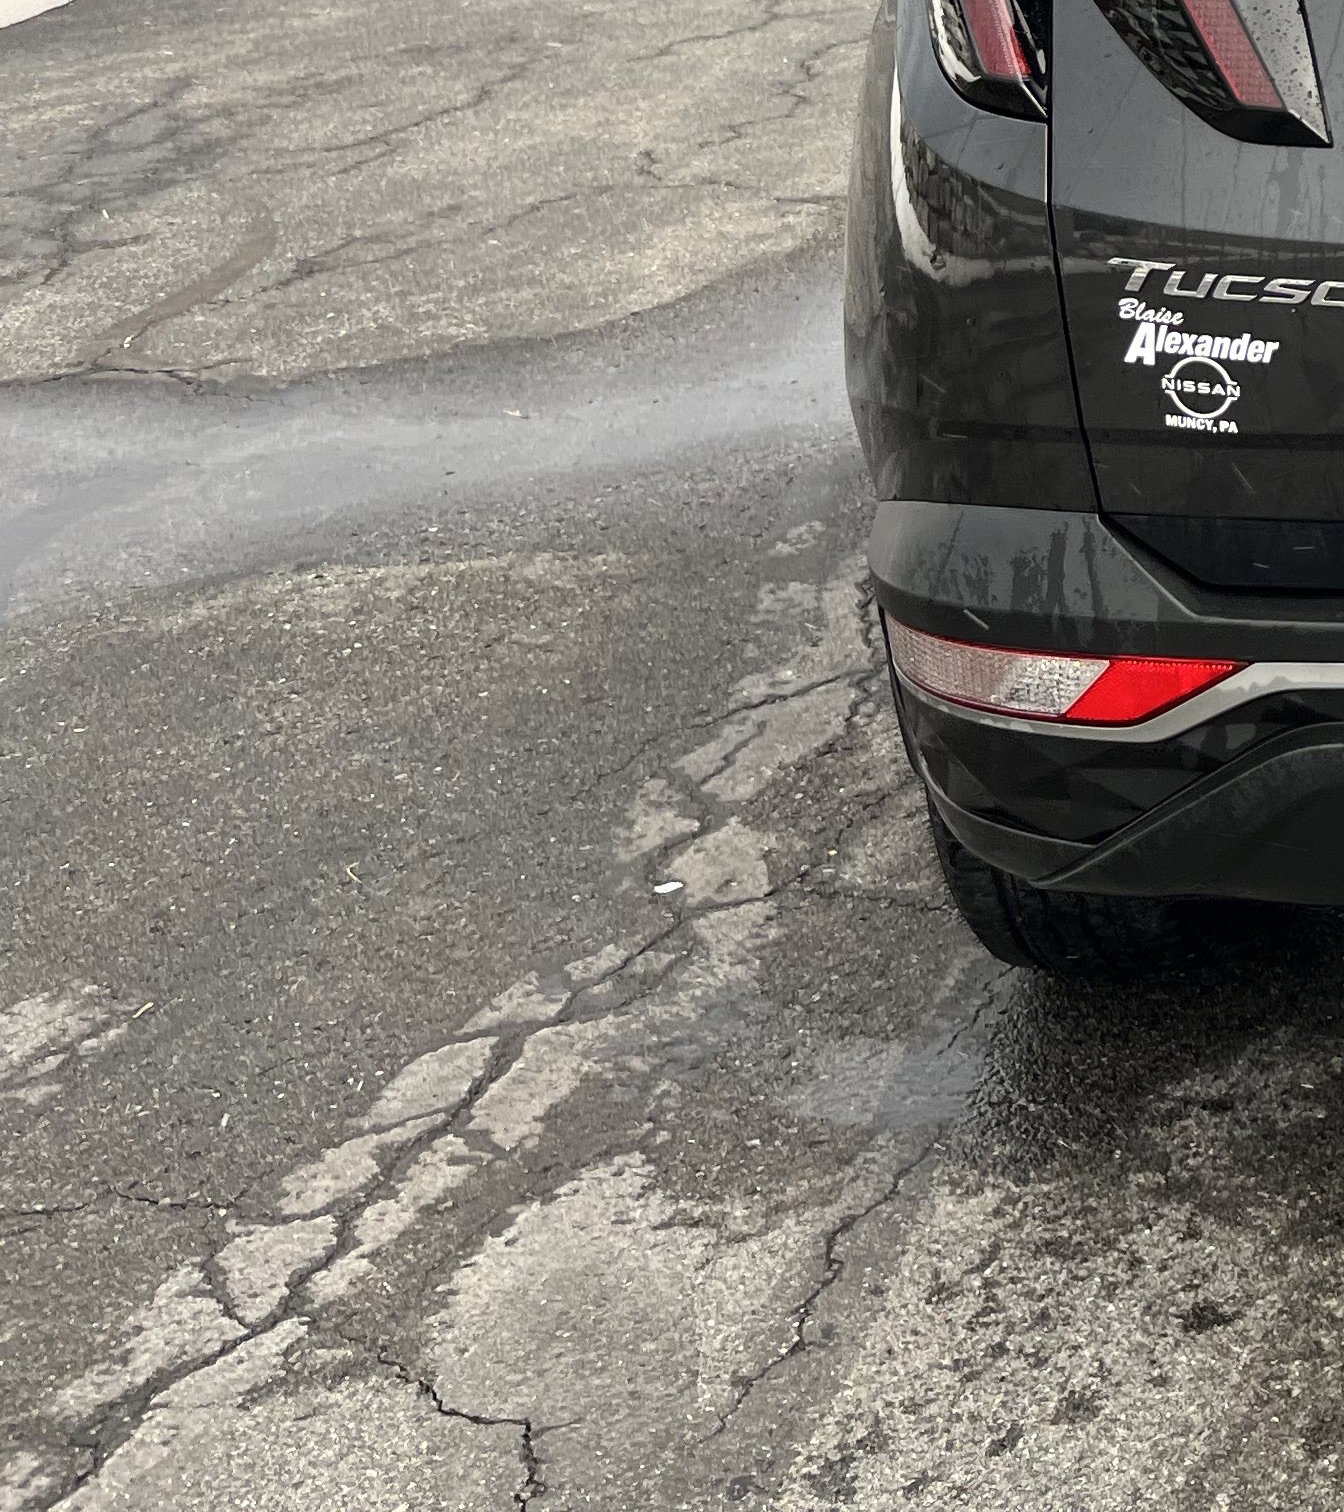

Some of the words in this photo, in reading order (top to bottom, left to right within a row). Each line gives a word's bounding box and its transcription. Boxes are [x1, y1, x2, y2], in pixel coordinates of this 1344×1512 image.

[1118, 297, 1185, 326] Blaise
[1123, 321, 1280, 366] Alexander
[1160, 376, 1241, 398] NISSAN
[1165, 413, 1218, 433] MUNCY,
[1218, 419, 1239, 434] PA
